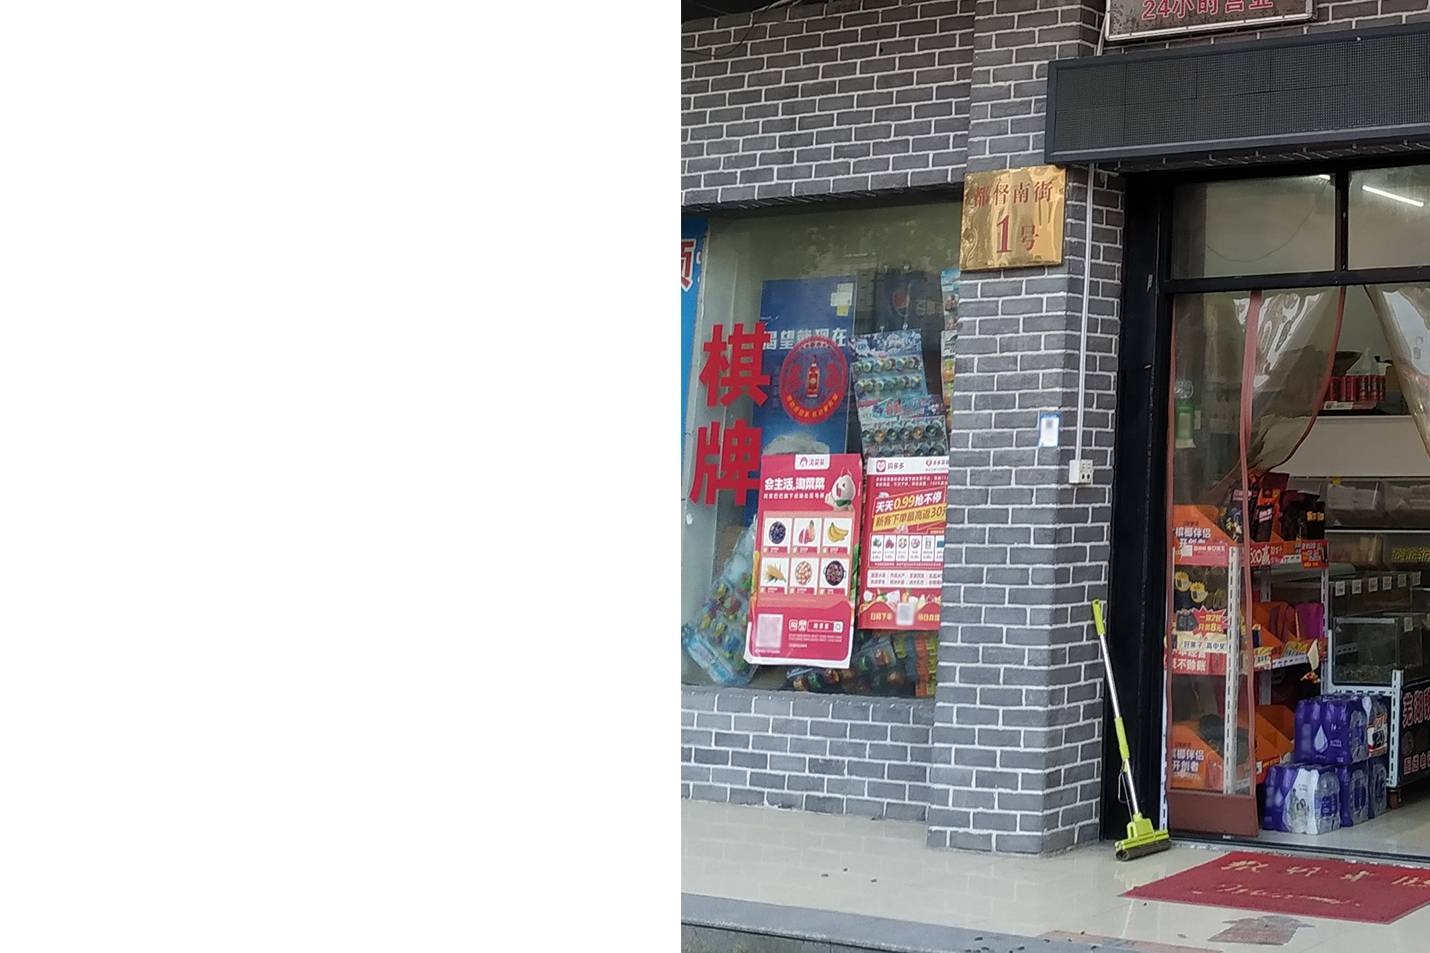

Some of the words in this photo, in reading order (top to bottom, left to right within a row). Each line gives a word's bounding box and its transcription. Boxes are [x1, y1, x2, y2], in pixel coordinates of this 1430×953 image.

[974, 181, 1053, 206] 都督南街
[996, 215, 1039, 254] 1号
[689, 322, 771, 507] 棋牌
[875, 491, 943, 514] 天天0.99抢不停
